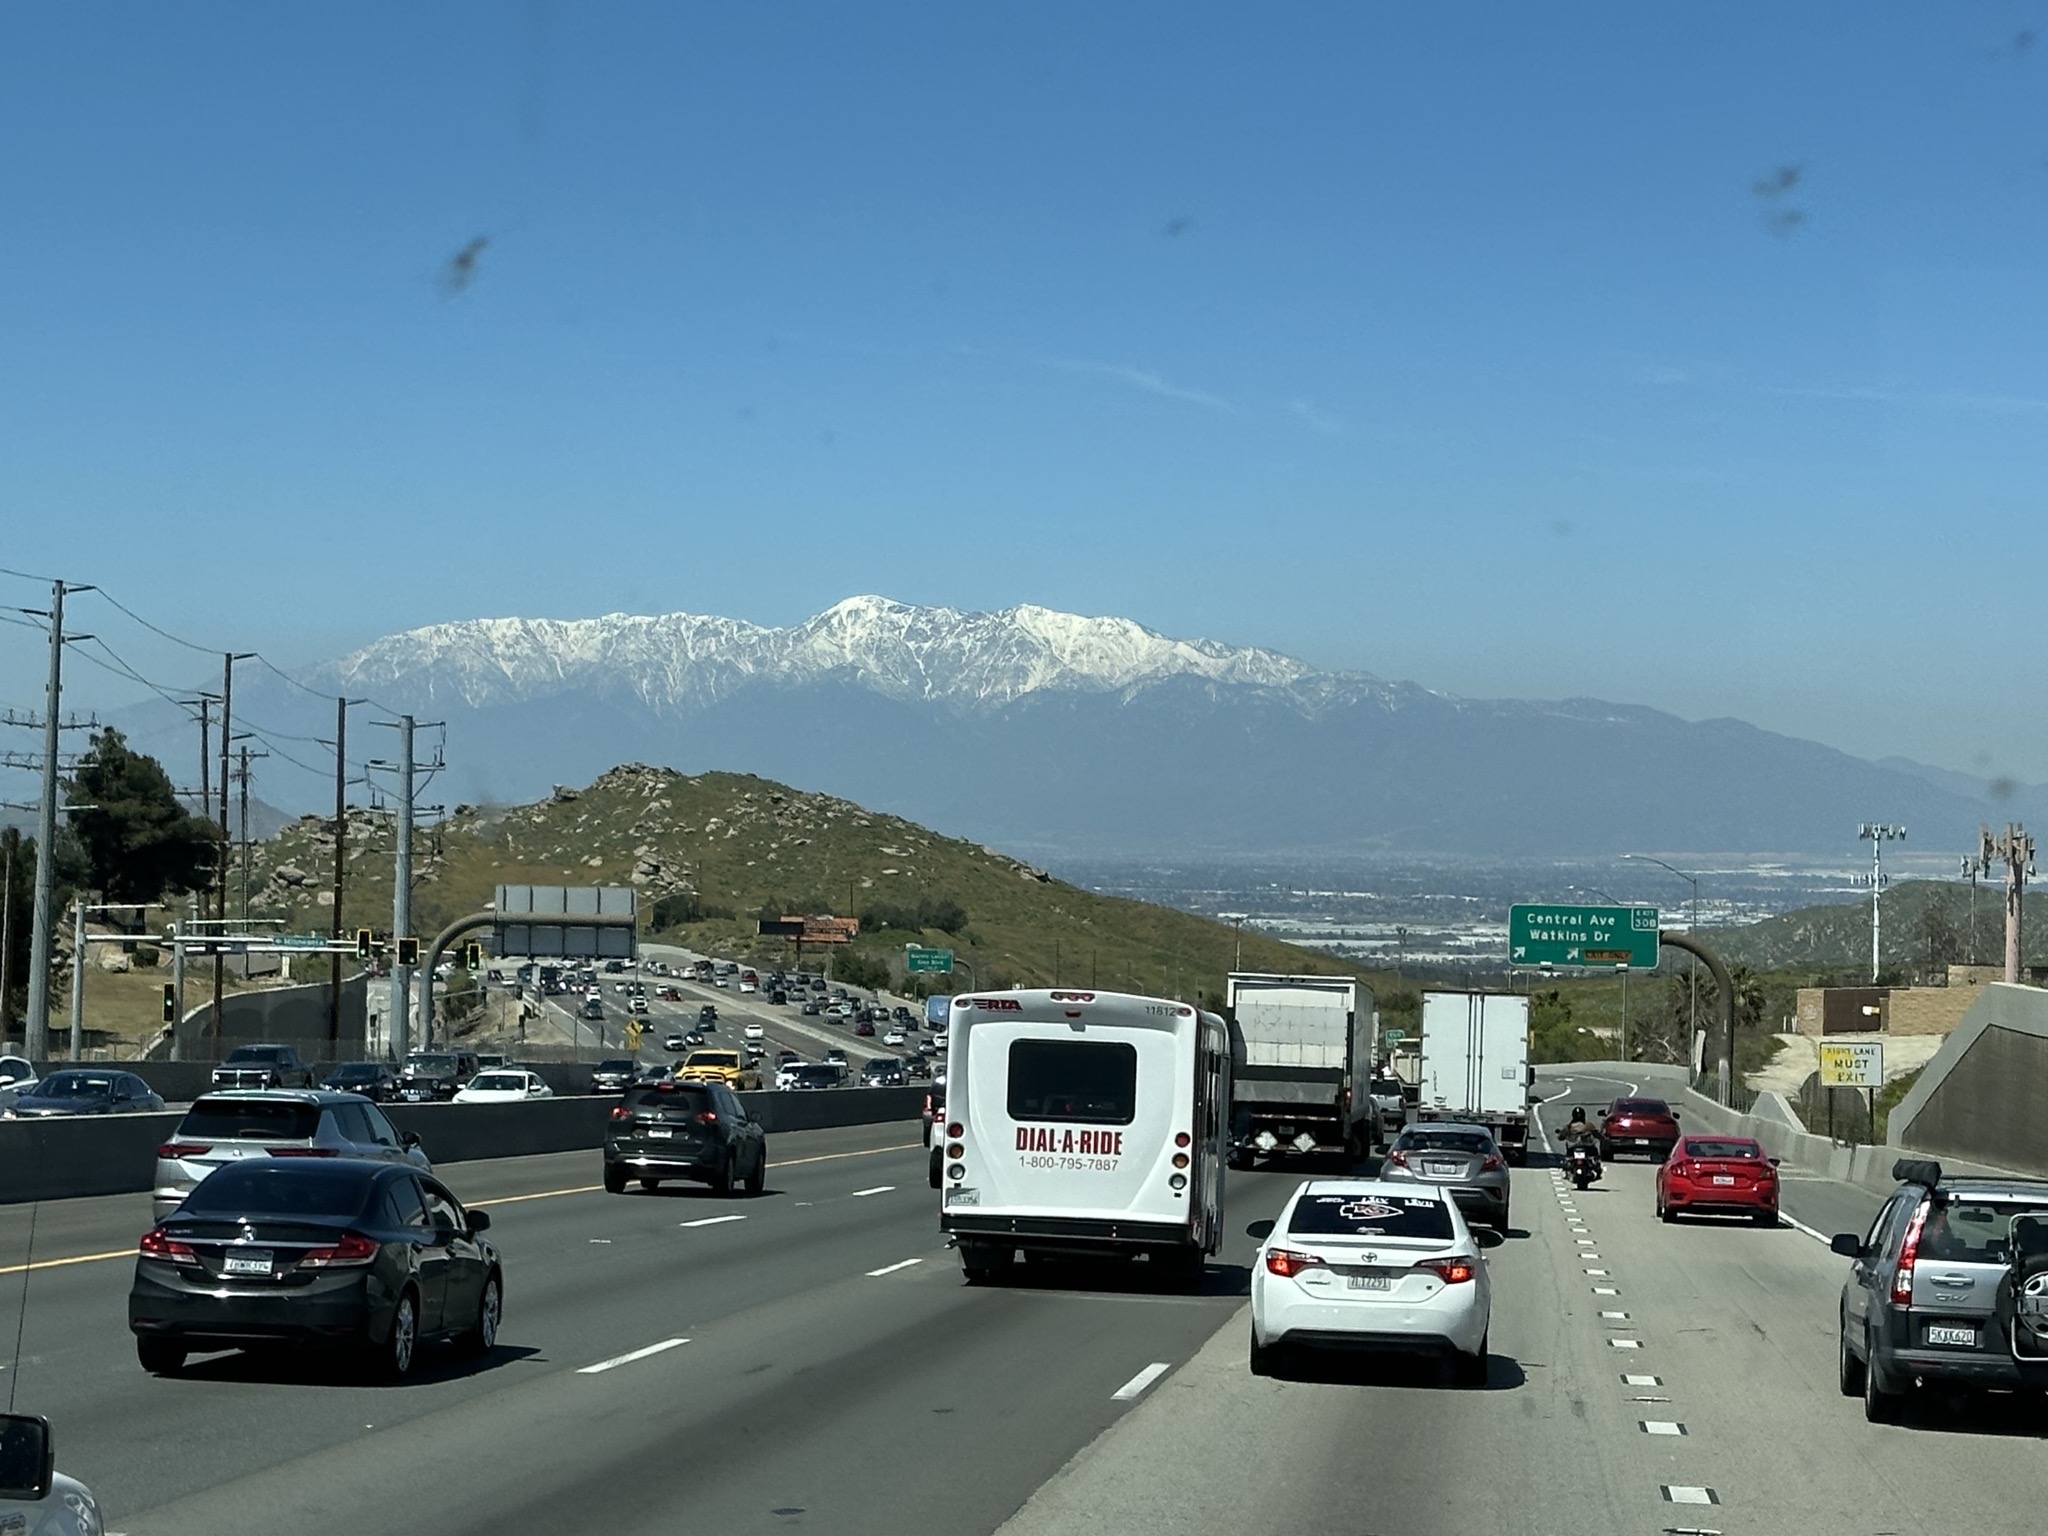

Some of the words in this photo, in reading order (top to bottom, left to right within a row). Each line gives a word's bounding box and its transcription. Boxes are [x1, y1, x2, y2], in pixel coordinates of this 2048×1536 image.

[1527, 913, 1582, 925] Central
[1590, 914, 1615, 926] Ave
[1529, 929, 1588, 942] Watkins
[1594, 931, 1611, 942] Dr
[1145, 1005, 1177, 1017] 11812
[1854, 1048, 1876, 1056] LANE
[1834, 1059, 1869, 1069] MUST
[1837, 1072, 1866, 1082] EXIT
[1019, 1156, 1119, 1172] 1-800-795-7887
